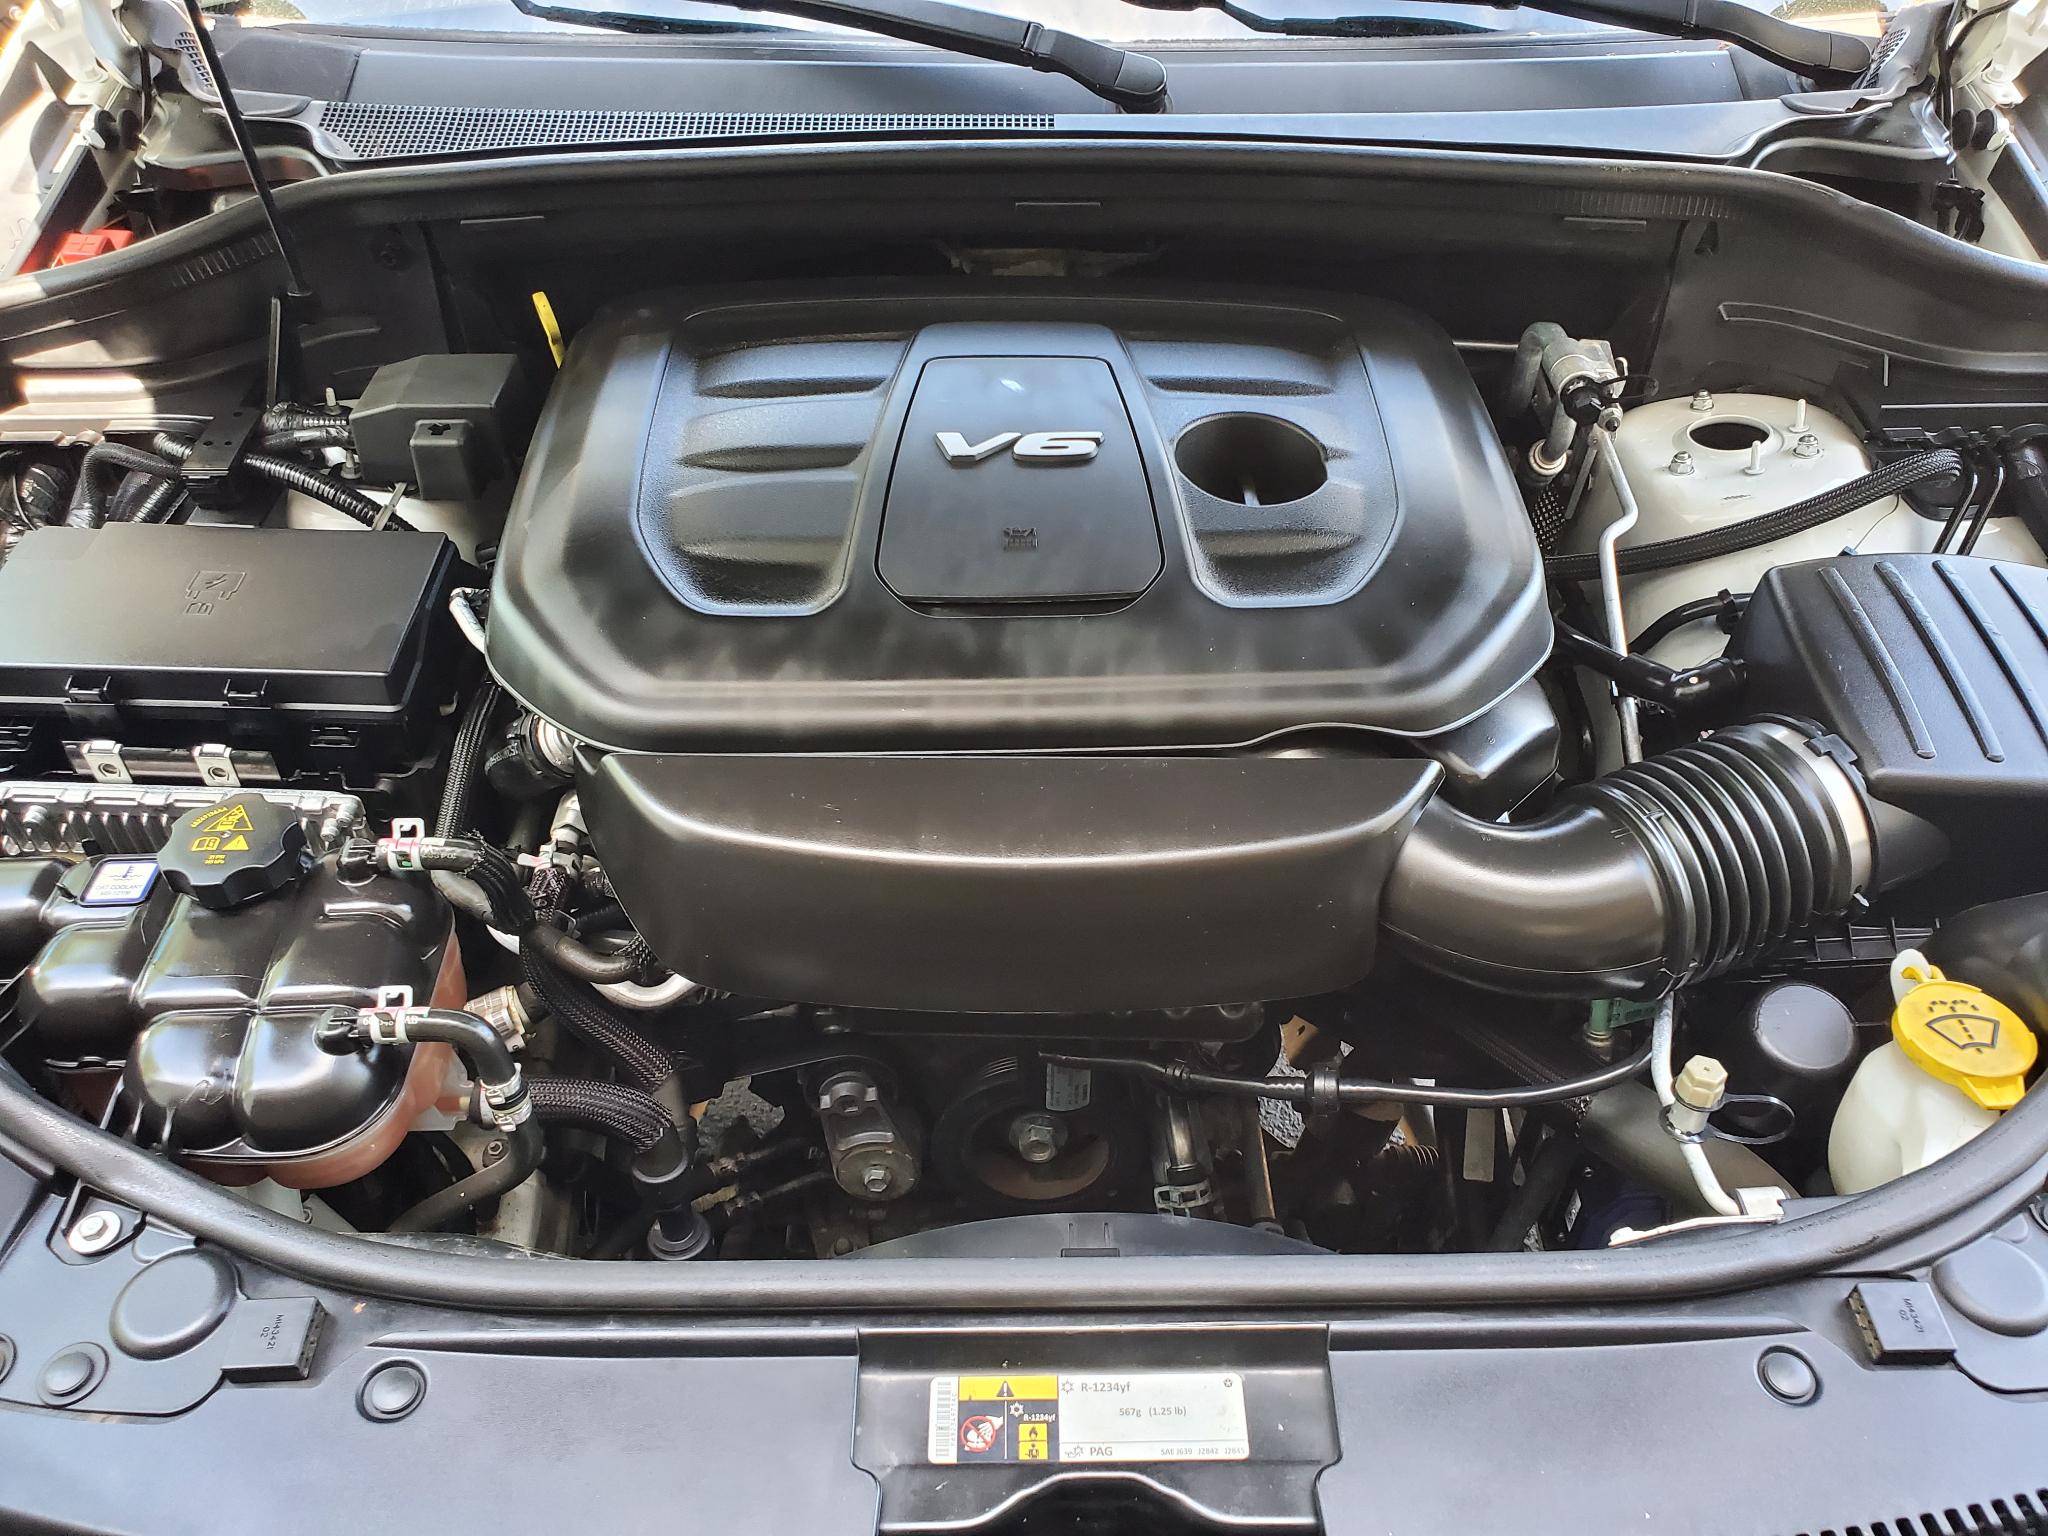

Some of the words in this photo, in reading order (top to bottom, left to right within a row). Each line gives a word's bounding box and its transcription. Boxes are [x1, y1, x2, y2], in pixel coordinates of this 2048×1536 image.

[935, 432, 1105, 463] V6
[1081, 1381, 1131, 1394] R-1234yf
[1023, 1413, 1056, 1423] R-1234yf
[1119, 1407, 1142, 1418] 567g
[1148, 1406, 1172, 1417] (1.25
[1174, 1406, 1187, 1417] lb)
[1089, 1446, 1113, 1457] PAG
